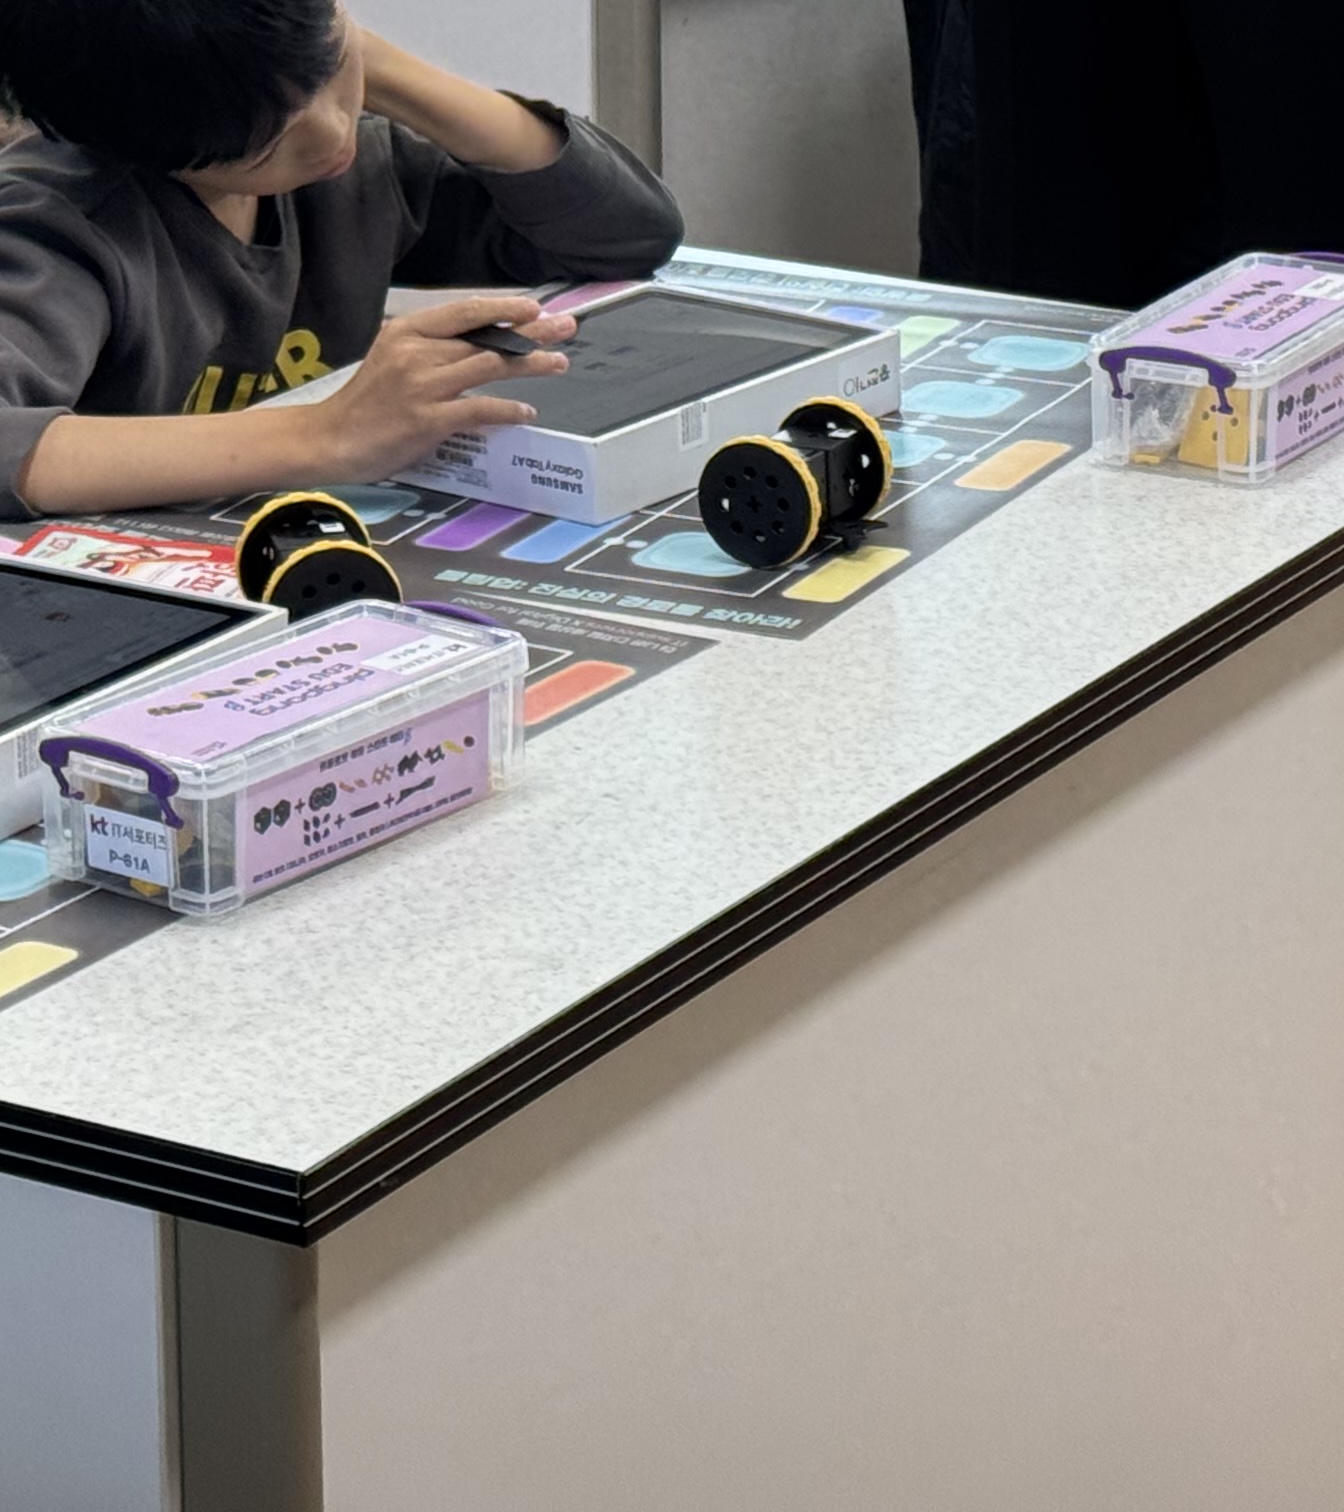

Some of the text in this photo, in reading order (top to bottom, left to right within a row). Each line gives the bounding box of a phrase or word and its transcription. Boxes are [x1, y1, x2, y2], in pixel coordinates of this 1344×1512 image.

[546, 459, 584, 480] Galaxy
[531, 473, 584, 495] SAMSUNG
[528, 581, 618, 604] 진실의
[244, 679, 311, 707] START
[248, 668, 375, 717] pingpong
[89, 813, 109, 837] kt
